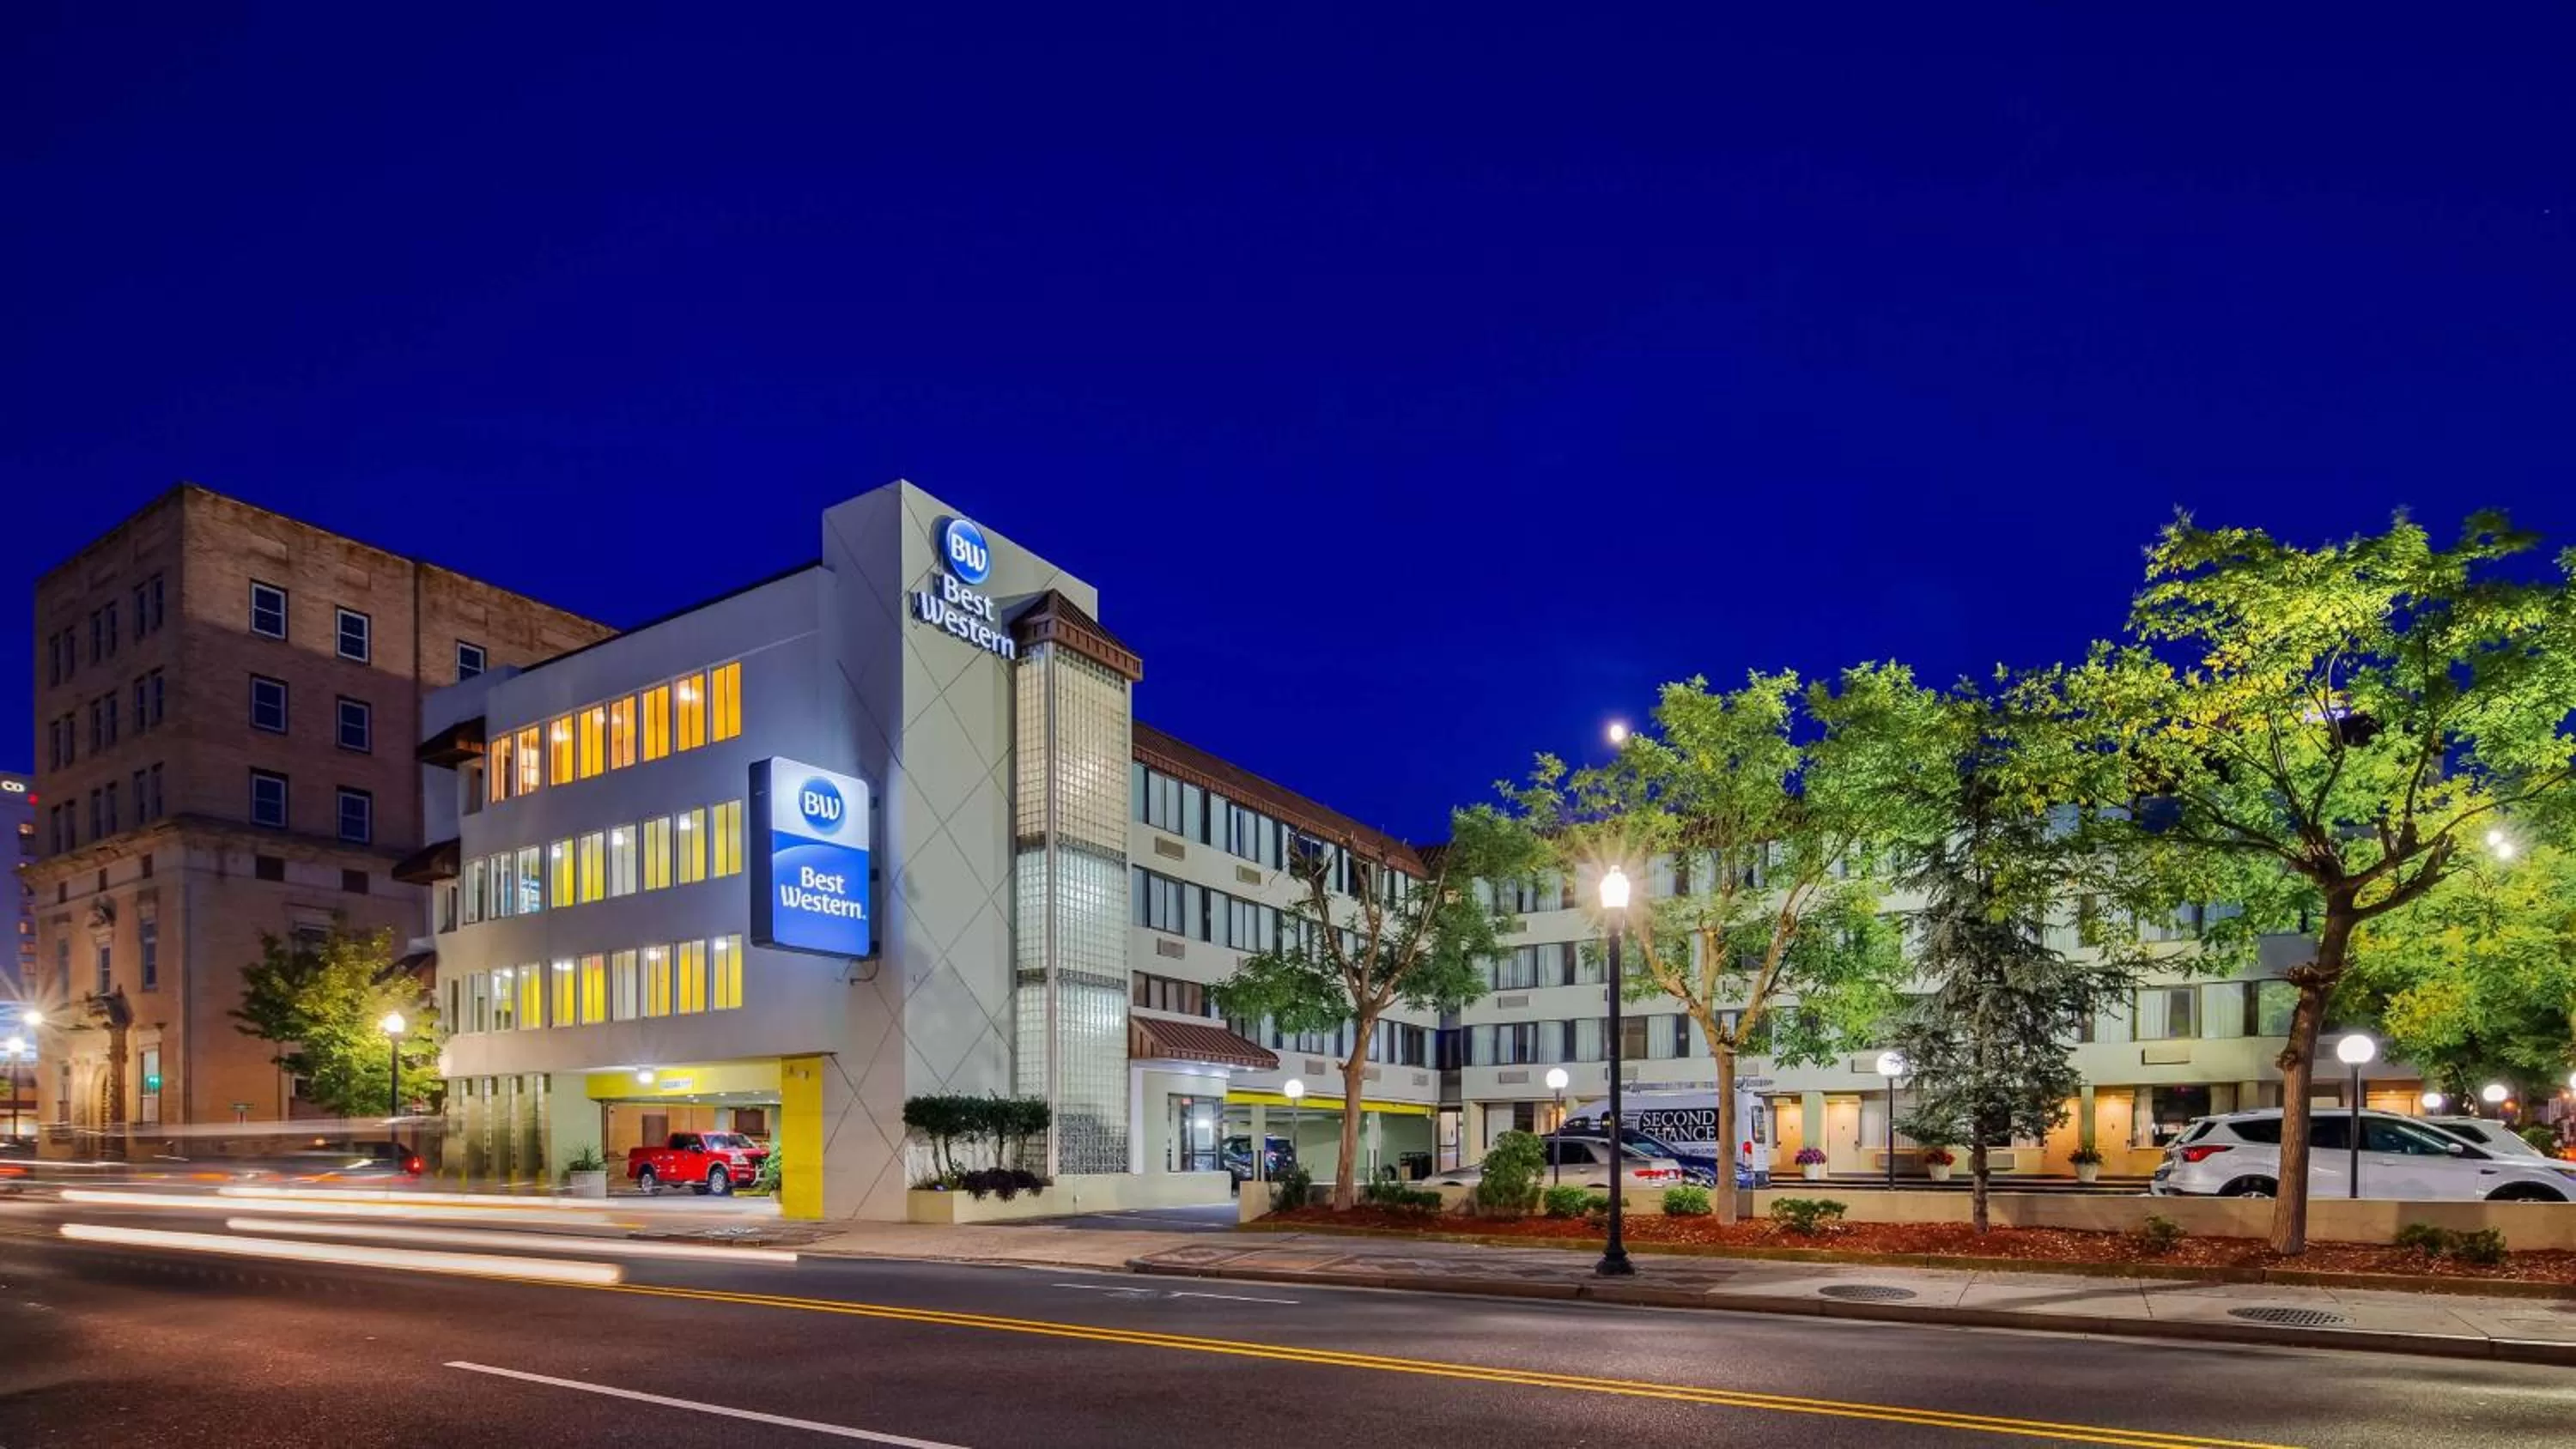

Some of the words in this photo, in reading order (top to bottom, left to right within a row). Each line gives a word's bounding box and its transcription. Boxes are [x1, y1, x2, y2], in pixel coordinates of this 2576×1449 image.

[950, 533, 987, 572] BW
[944, 573, 994, 621] Best
[921, 591, 1015, 660] Western
[804, 791, 841, 820] BW
[800, 866, 846, 895] Best
[1643, 1110, 1716, 1127] SECOND
